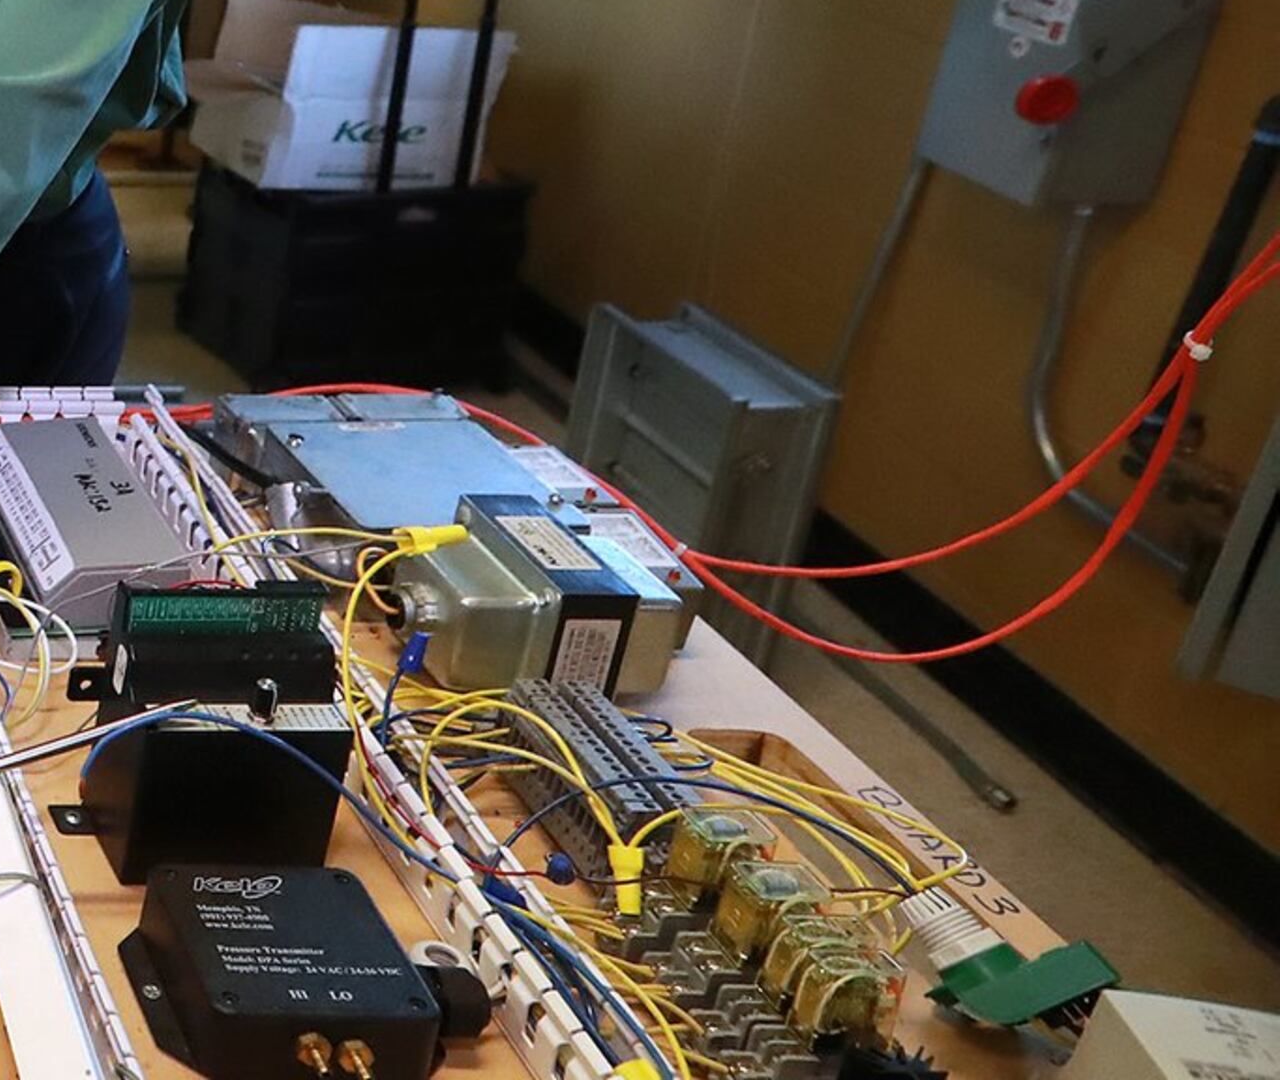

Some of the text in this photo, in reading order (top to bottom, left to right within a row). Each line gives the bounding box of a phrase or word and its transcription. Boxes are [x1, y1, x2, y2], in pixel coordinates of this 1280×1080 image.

[332, 120, 428, 144] Kee
[193, 875, 282, 899] Kele
[289, 989, 353, 1001] HI LO
